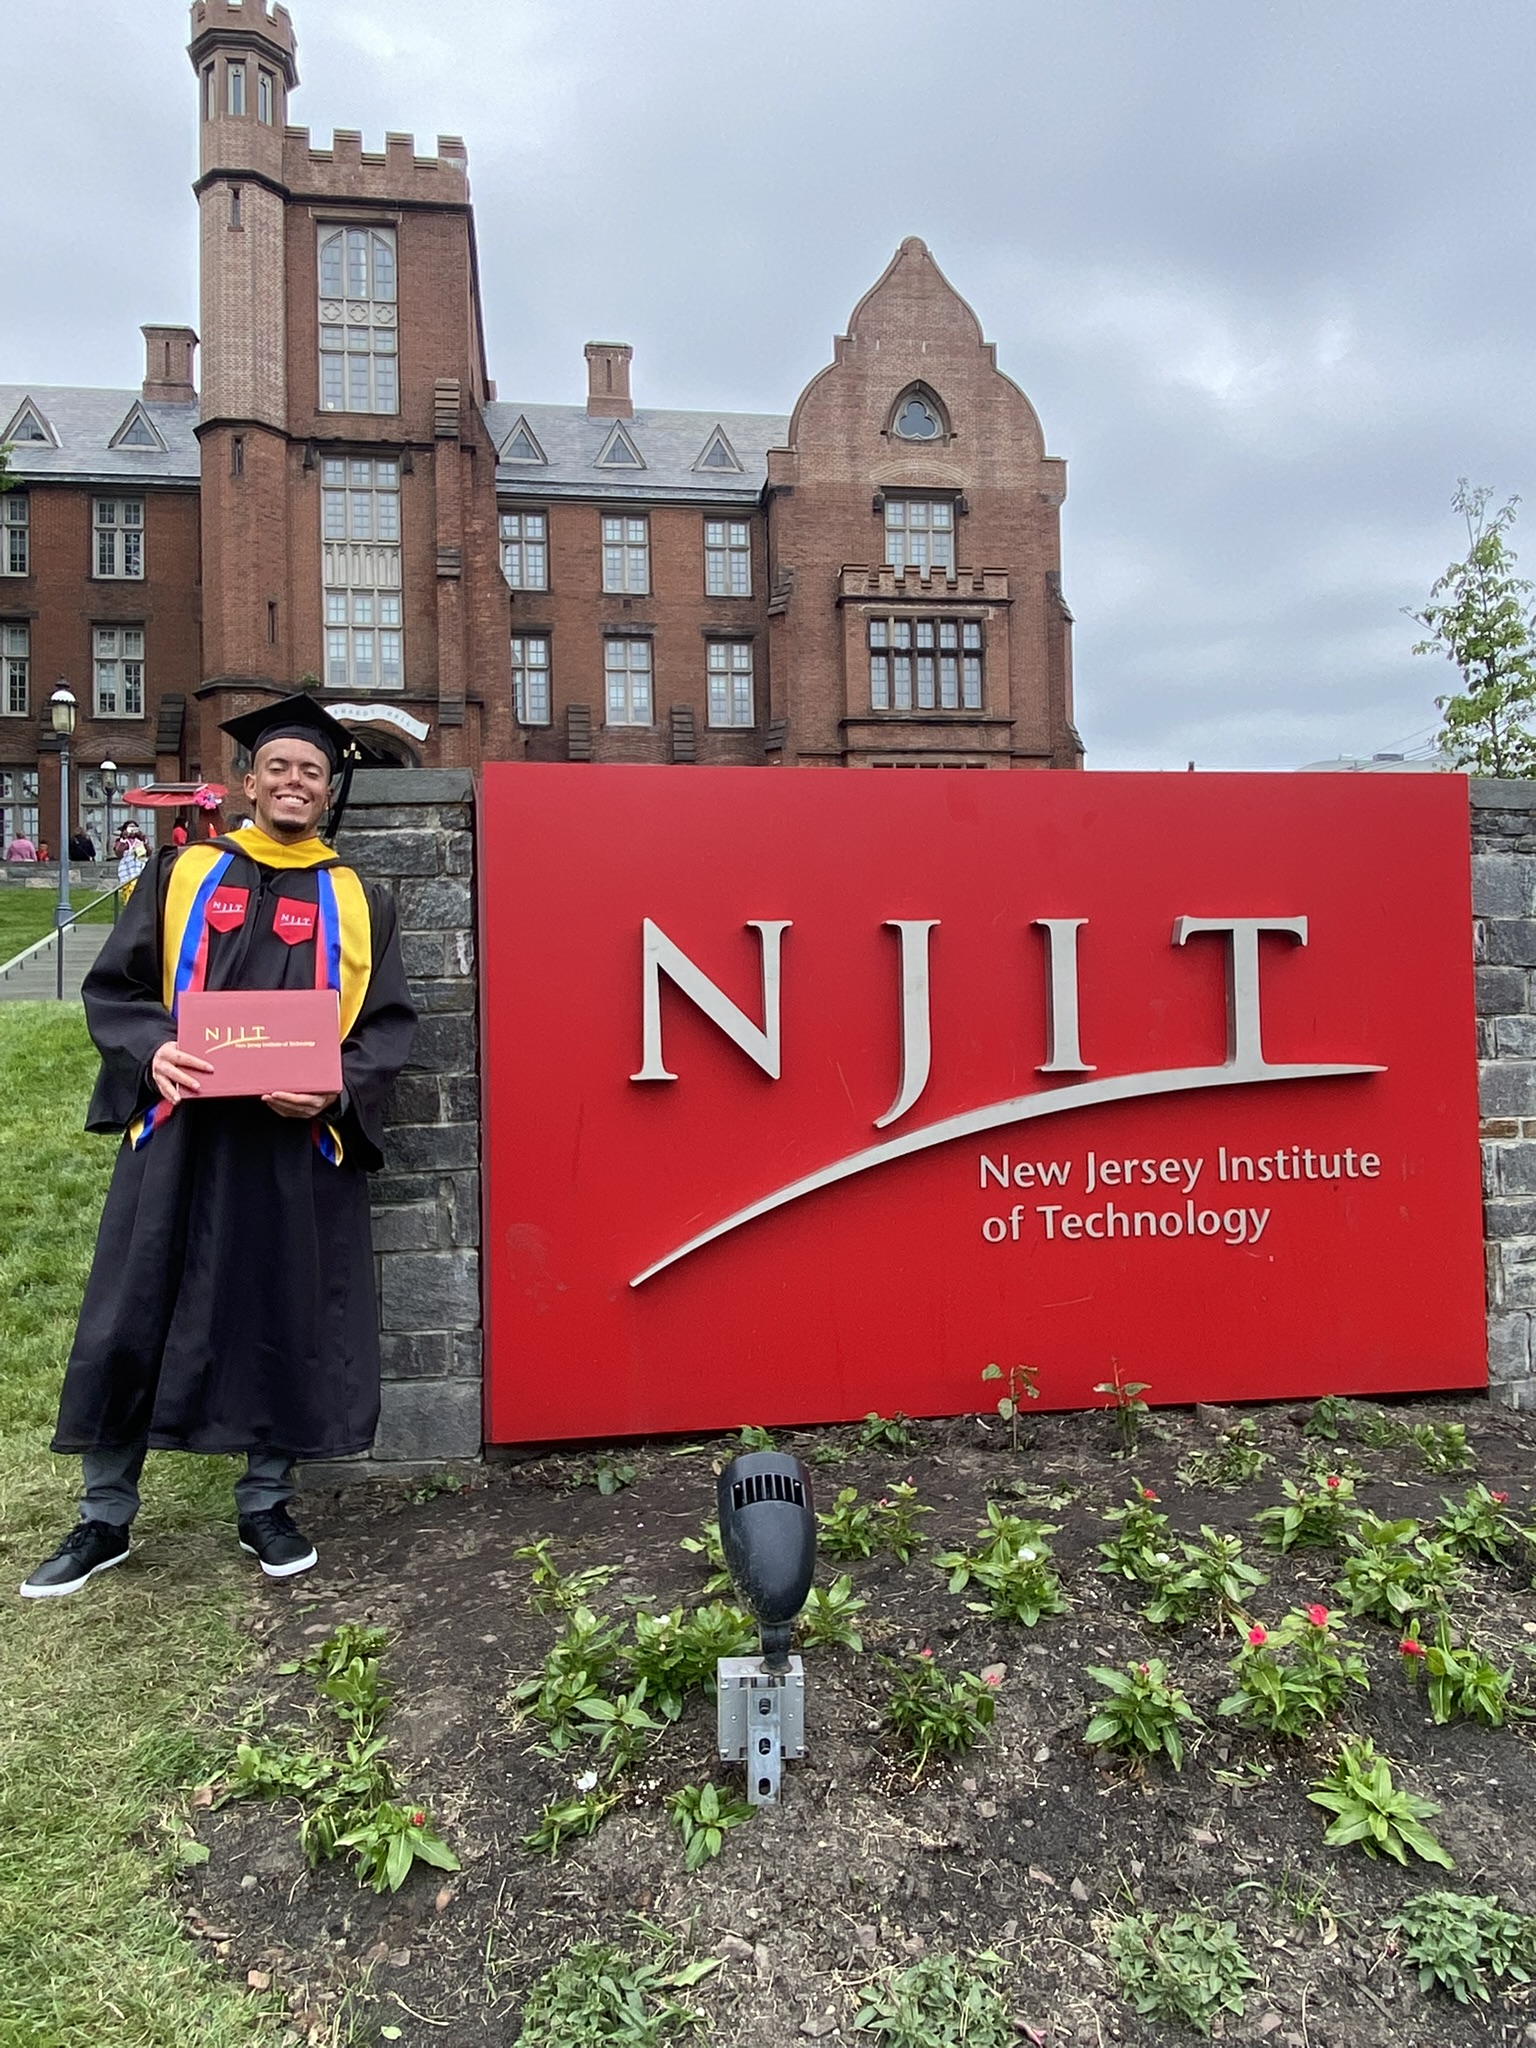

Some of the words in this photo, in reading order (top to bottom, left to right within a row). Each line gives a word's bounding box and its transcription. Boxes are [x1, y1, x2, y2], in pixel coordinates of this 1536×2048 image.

[386, 710, 411, 727] HALL
[212, 900, 243, 912] NJIT
[280, 913, 312, 925] NJIT
[629, 915, 1308, 1129] NJIT
[205, 1026, 266, 1042] NJIT
[979, 1153, 1072, 1189] New
[1085, 1151, 1204, 1194] Jersey
[1218, 1145, 1381, 1183] Institute
[981, 1204, 1025, 1242] of
[1035, 1199, 1271, 1245] Technology
